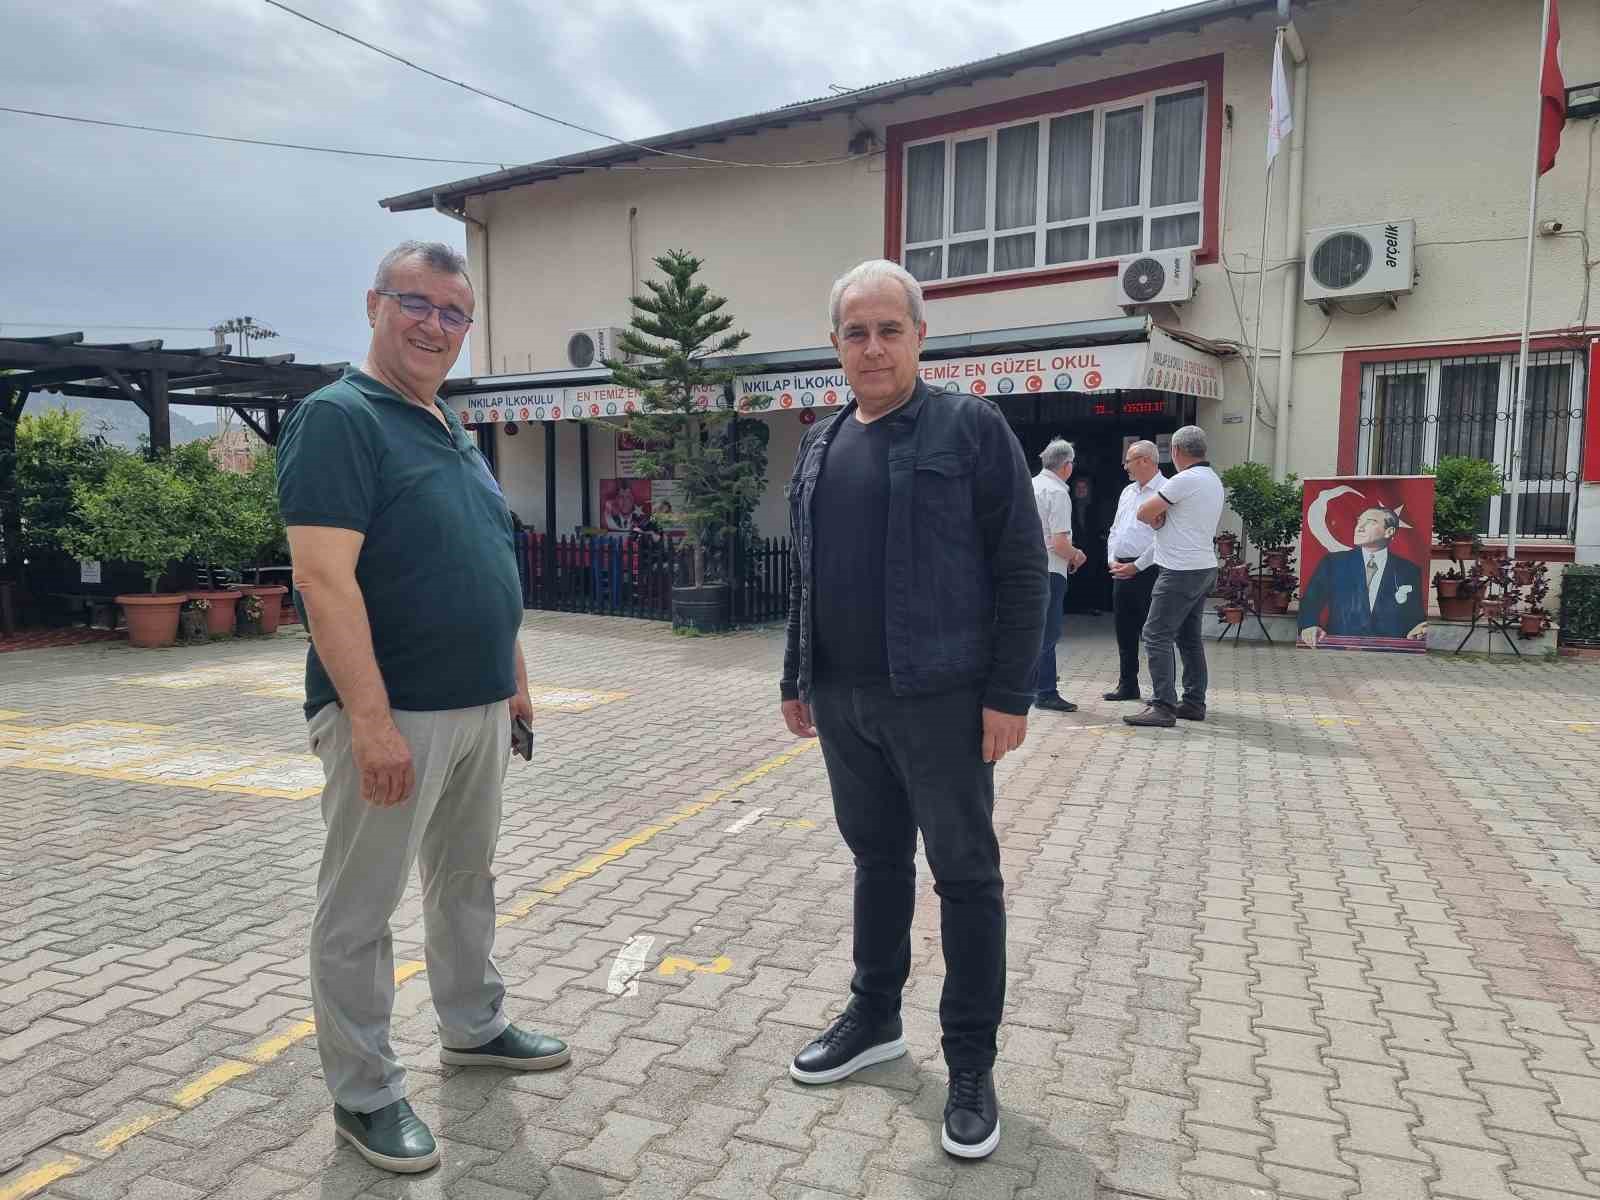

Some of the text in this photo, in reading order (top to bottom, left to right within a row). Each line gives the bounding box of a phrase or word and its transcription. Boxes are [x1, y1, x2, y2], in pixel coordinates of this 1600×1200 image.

[1385, 224, 1400, 268] arçelik
[964, 363, 986, 377] EN
[991, 357, 1046, 375] GÜZEL
[1051, 354, 1102, 370] OKUL
[794, 375, 850, 390] İLKOKUL
[576, 391, 591, 401] EN
